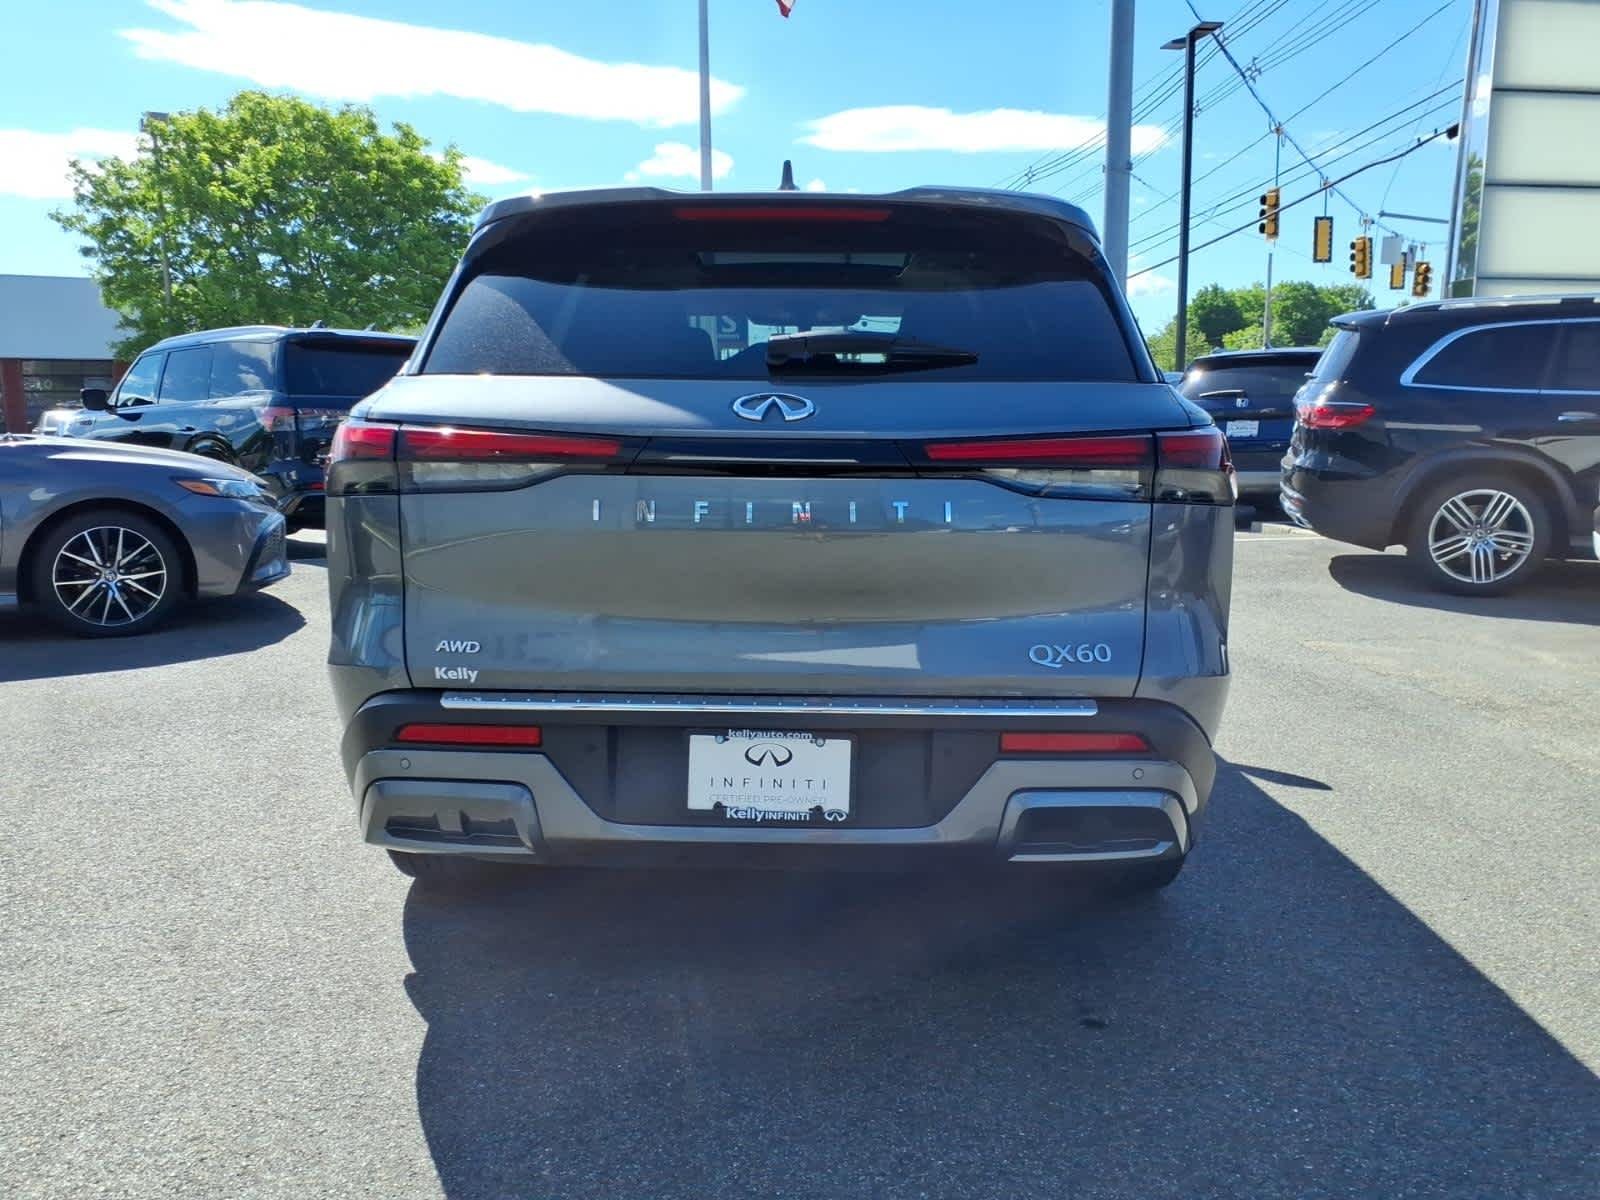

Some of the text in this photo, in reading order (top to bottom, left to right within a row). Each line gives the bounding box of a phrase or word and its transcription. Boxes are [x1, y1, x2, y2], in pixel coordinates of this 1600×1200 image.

[592, 499, 952, 524] INFINITI
[435, 640, 481, 653] AWD
[1028, 643, 1112, 668] QX60
[434, 666, 479, 684] Kelly
[728, 729, 813, 740] kellyauto.com
[709, 777, 827, 790] INFINITI
